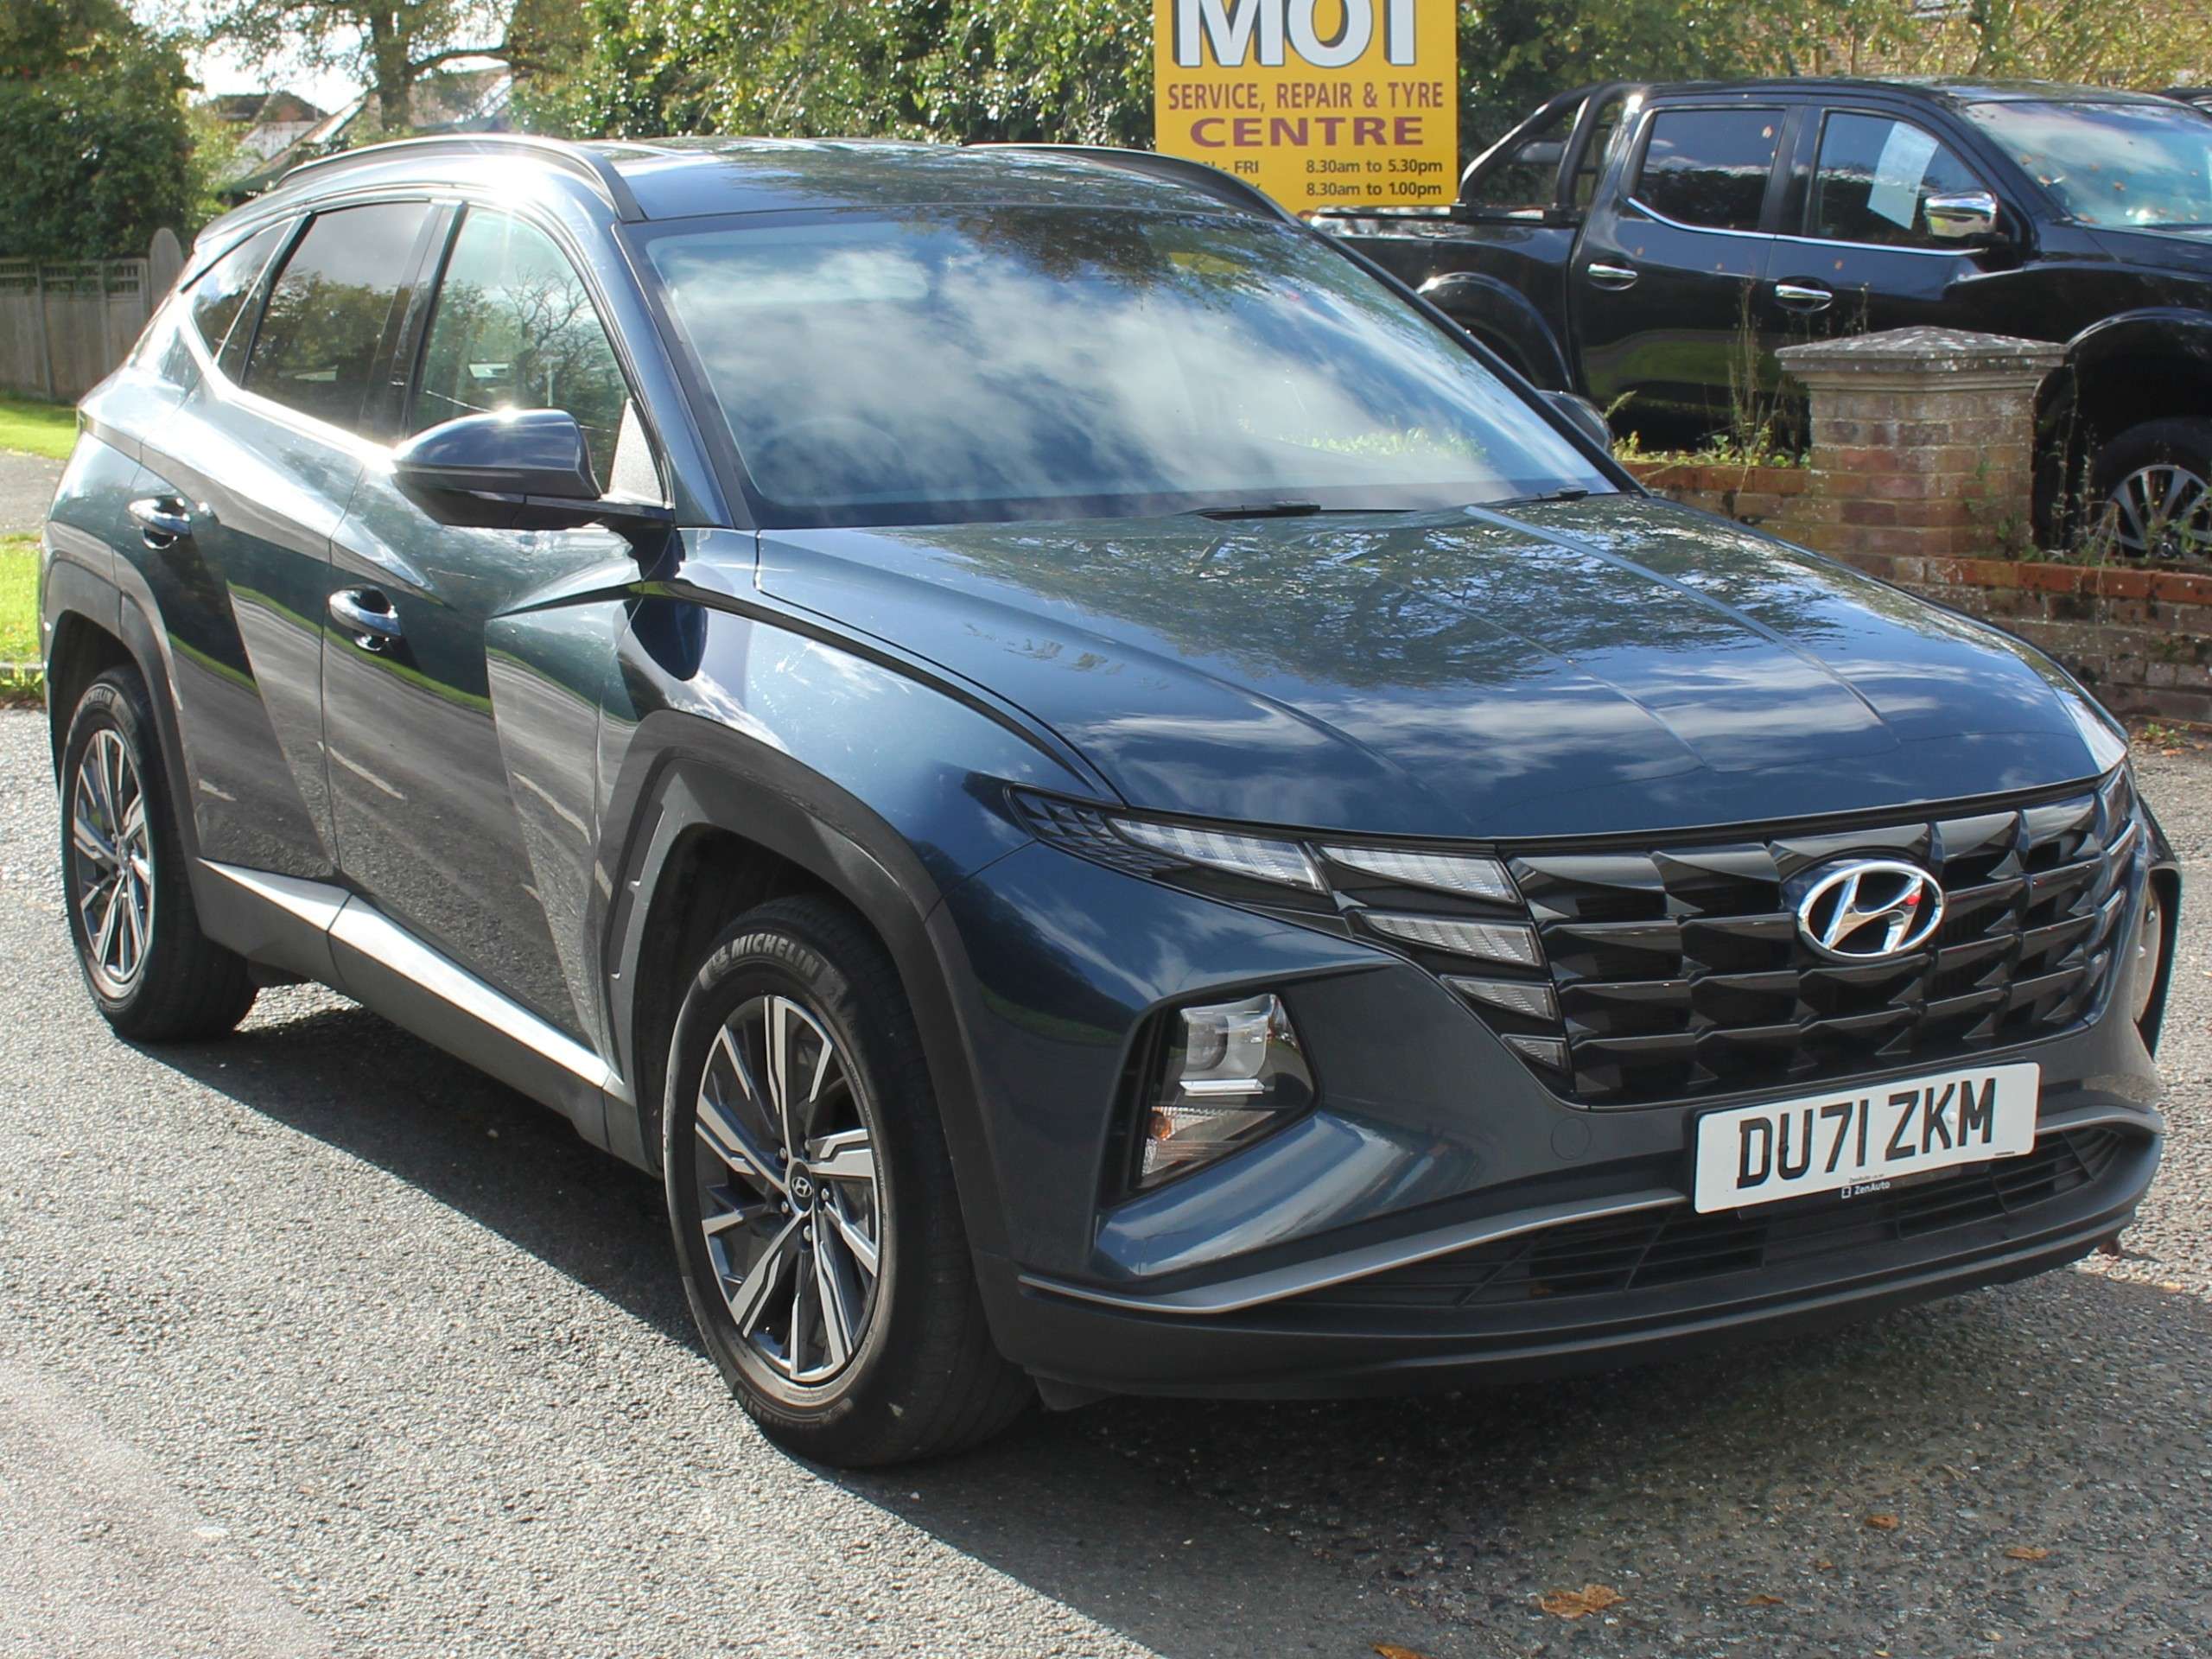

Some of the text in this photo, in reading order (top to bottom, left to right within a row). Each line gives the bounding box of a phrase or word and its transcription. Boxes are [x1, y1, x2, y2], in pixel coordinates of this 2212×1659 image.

[1168, 82, 1444, 112] SERVICE, REPAIR & TYRE
[1190, 117, 1423, 147] CENTRE
[1234, 161, 1259, 174] FRI
[1306, 160, 1360, 173] 8.30am
[1366, 161, 1382, 173] to
[1388, 160, 1443, 177] 5.30pm
[1306, 182, 1442, 200] 8.30am to 1.00pm
[731, 933, 819, 977] MICHELIN
[1737, 1077, 1997, 1189] DU71 ZKM
[1854, 1181, 1891, 1195] ZenAuto
